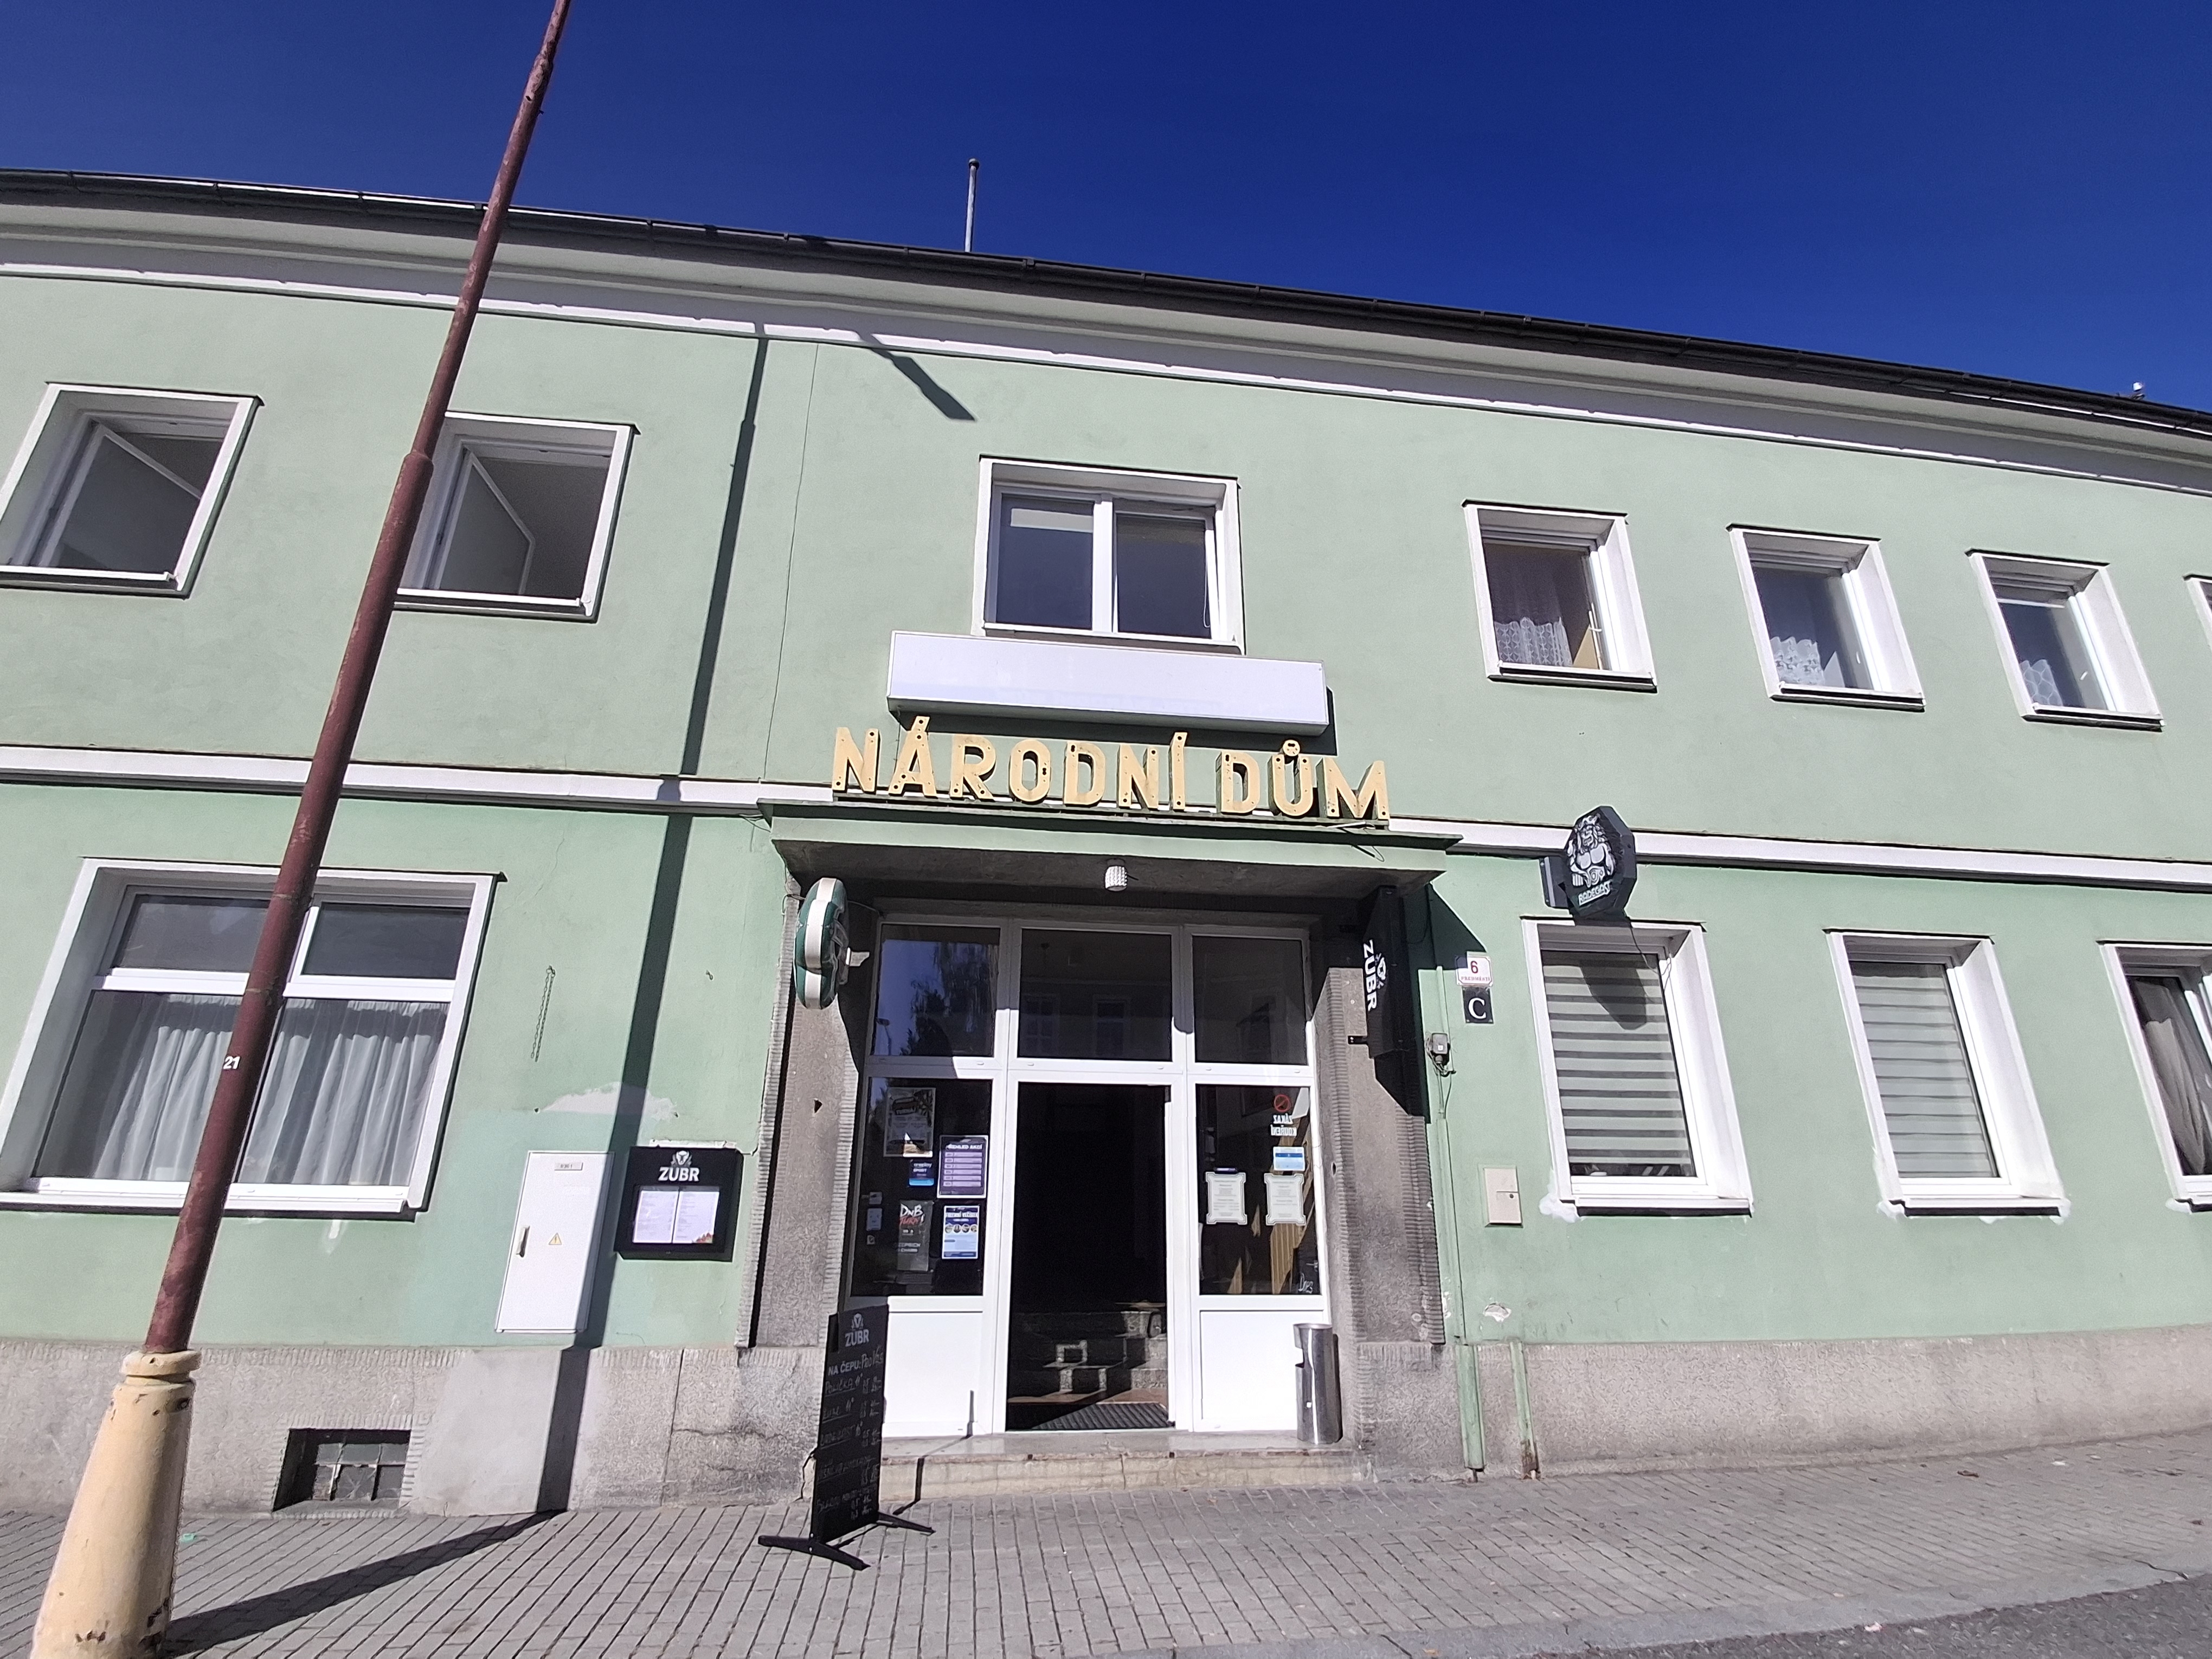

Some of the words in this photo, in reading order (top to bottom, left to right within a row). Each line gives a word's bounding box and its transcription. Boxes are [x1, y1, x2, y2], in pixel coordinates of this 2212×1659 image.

[832, 716, 1187, 811] NÁRODNÍ
[1215, 738, 1390, 820] DŮM
[1578, 879, 1612, 906] RADEGAST
[1363, 940, 1377, 1012] ZUBR
[1470, 960, 1478, 974] 6
[1468, 998, 1487, 1019] C
[223, 1056, 240, 1069] 21
[658, 1167, 700, 1181] ZUBR
[845, 1329, 869, 1347] ZUBR
[828, 1365, 838, 1376] NA
[840, 1361, 861, 1373] ČEPU:
